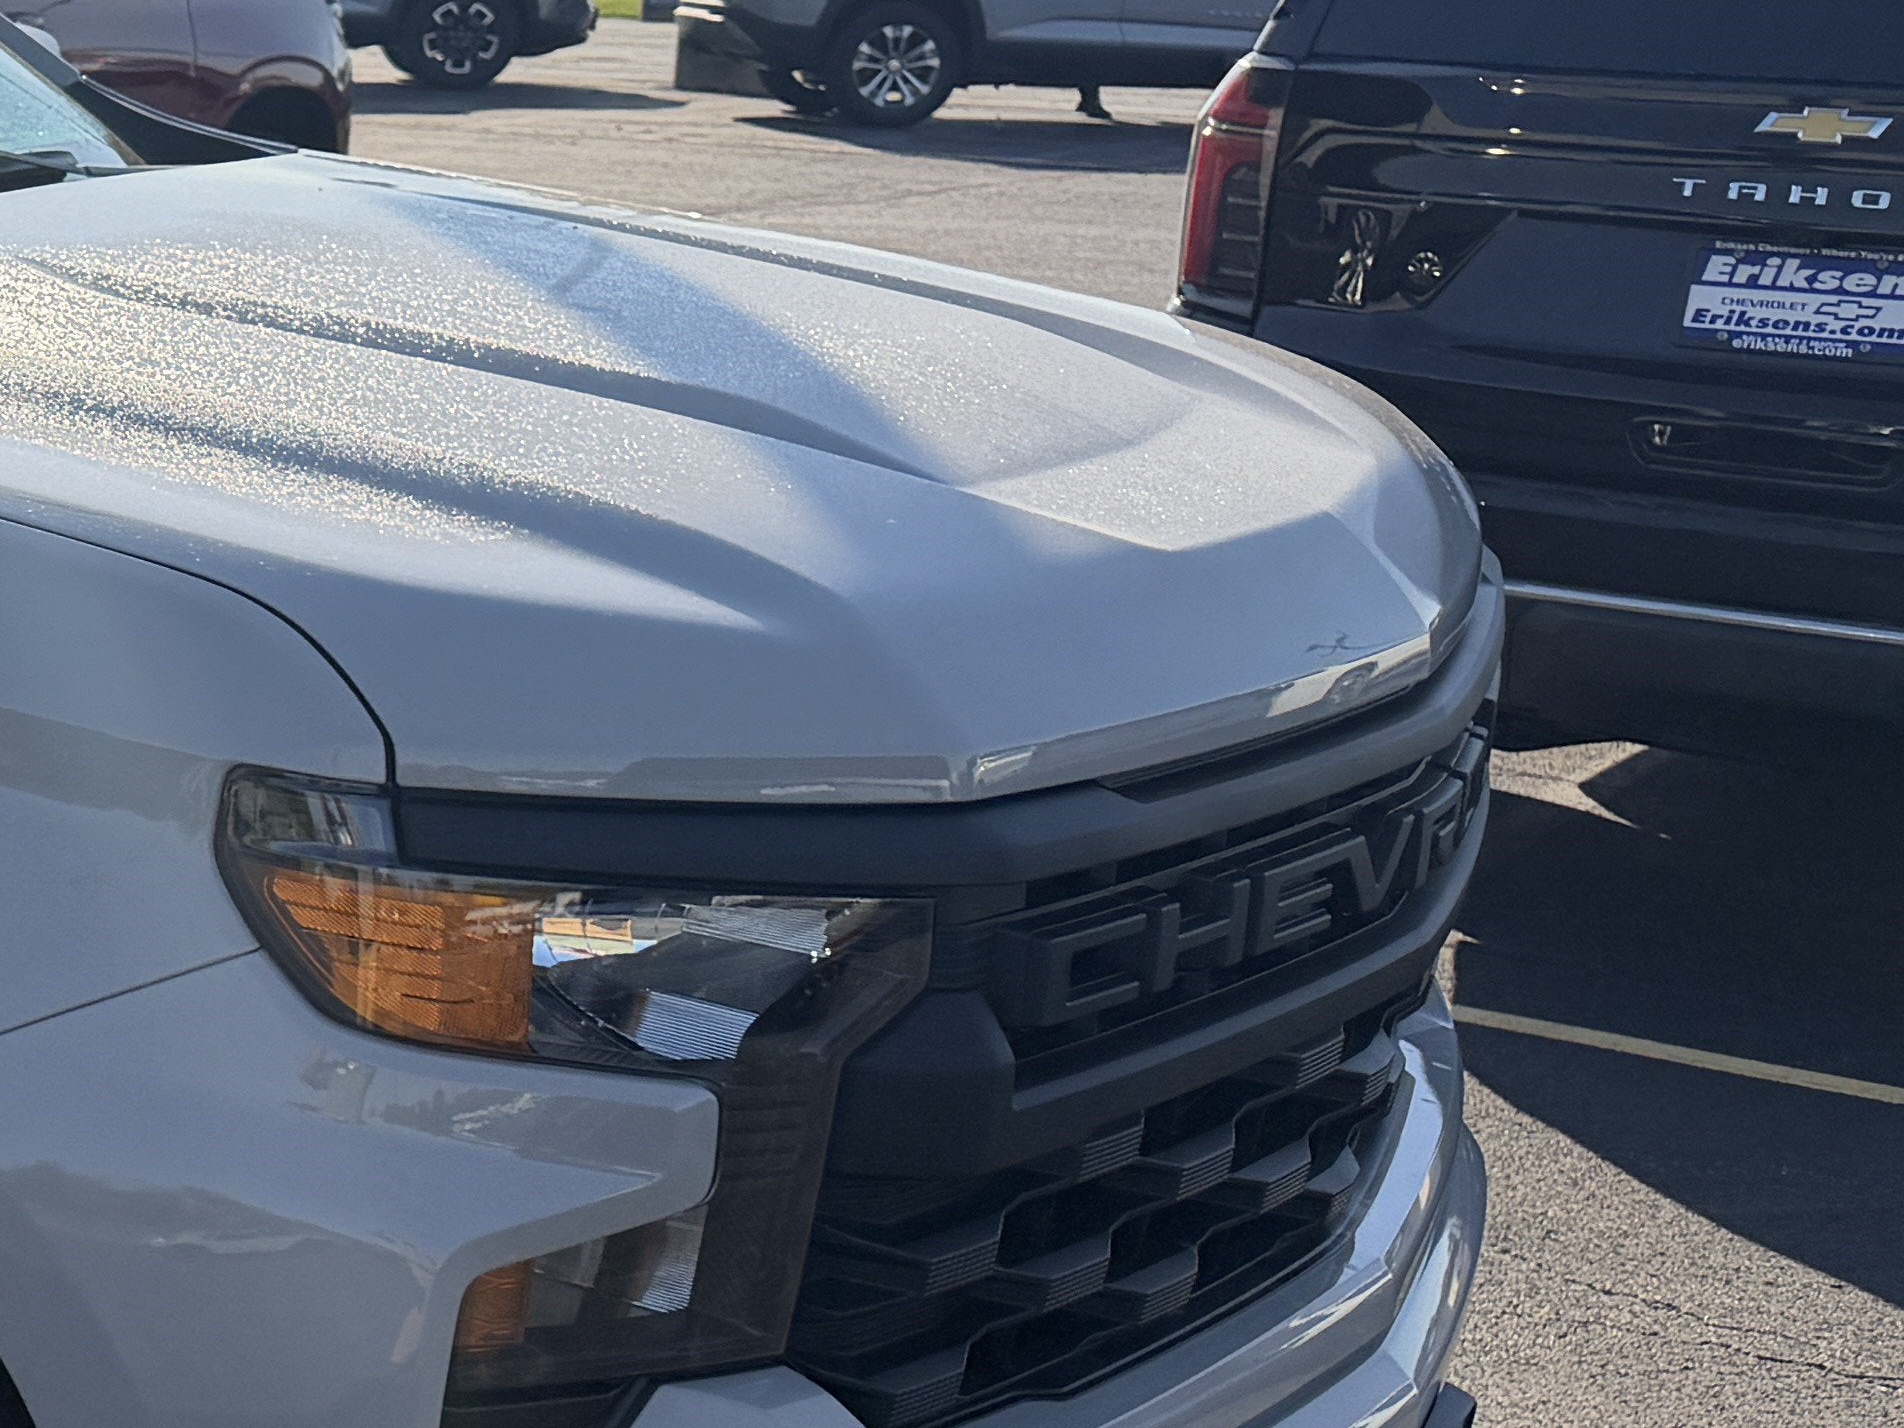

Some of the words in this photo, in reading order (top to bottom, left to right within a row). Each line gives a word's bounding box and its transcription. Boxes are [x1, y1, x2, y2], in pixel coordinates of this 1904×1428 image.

[1700, 254, 1904, 296] Eriksen
[1720, 296, 1809, 312] CHEVROLET
[1690, 307, 1904, 341] Eriksens.com
[1732, 336, 1854, 358] eriksens.com
